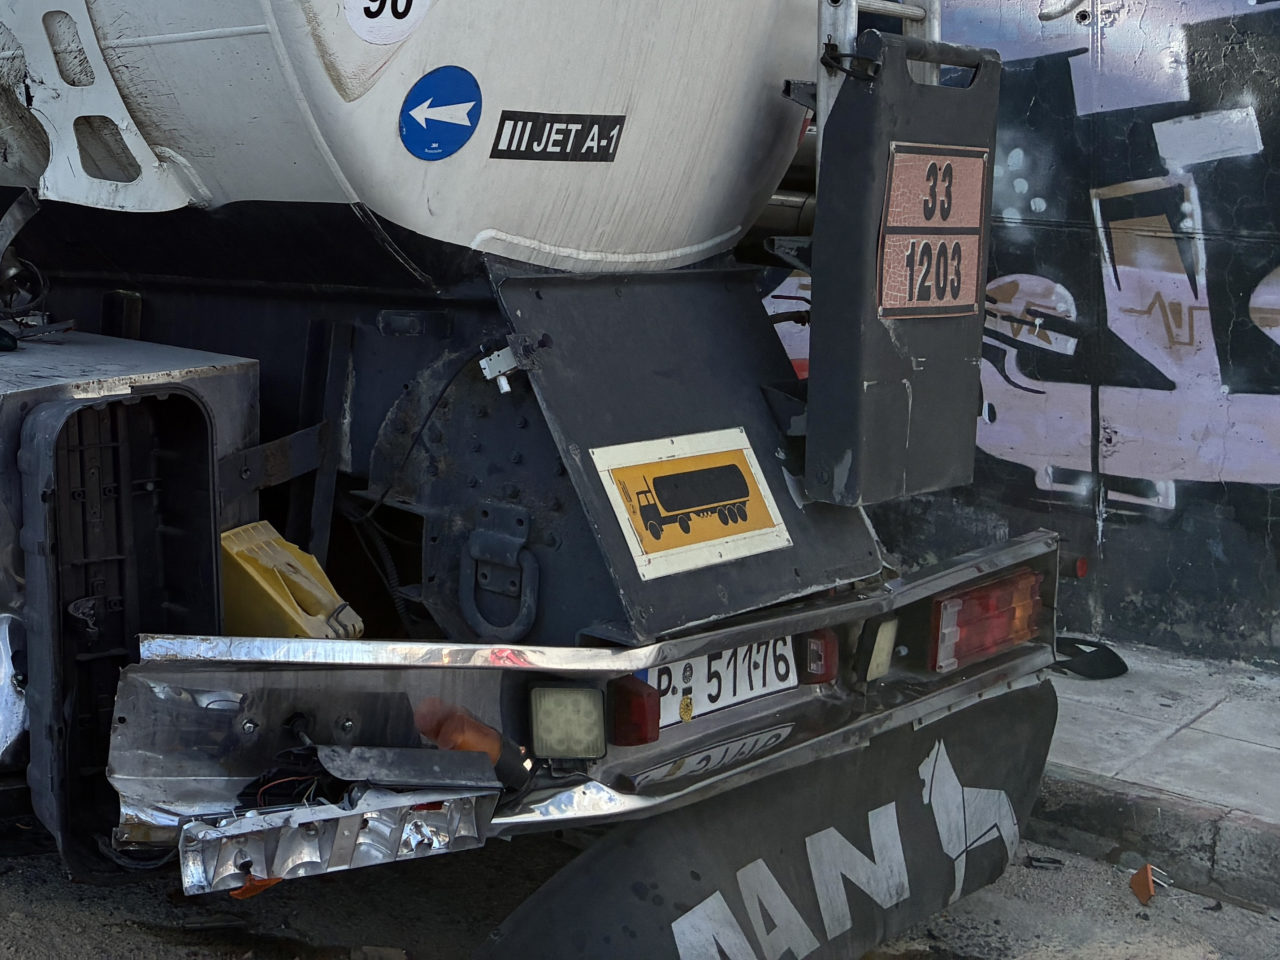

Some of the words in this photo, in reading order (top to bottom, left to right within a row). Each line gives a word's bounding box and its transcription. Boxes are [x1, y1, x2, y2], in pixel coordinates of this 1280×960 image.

[532, 122, 582, 153] JET
[581, 124, 620, 154] A-1
[922, 160, 953, 222] 33
[904, 239, 962, 302] 1203
